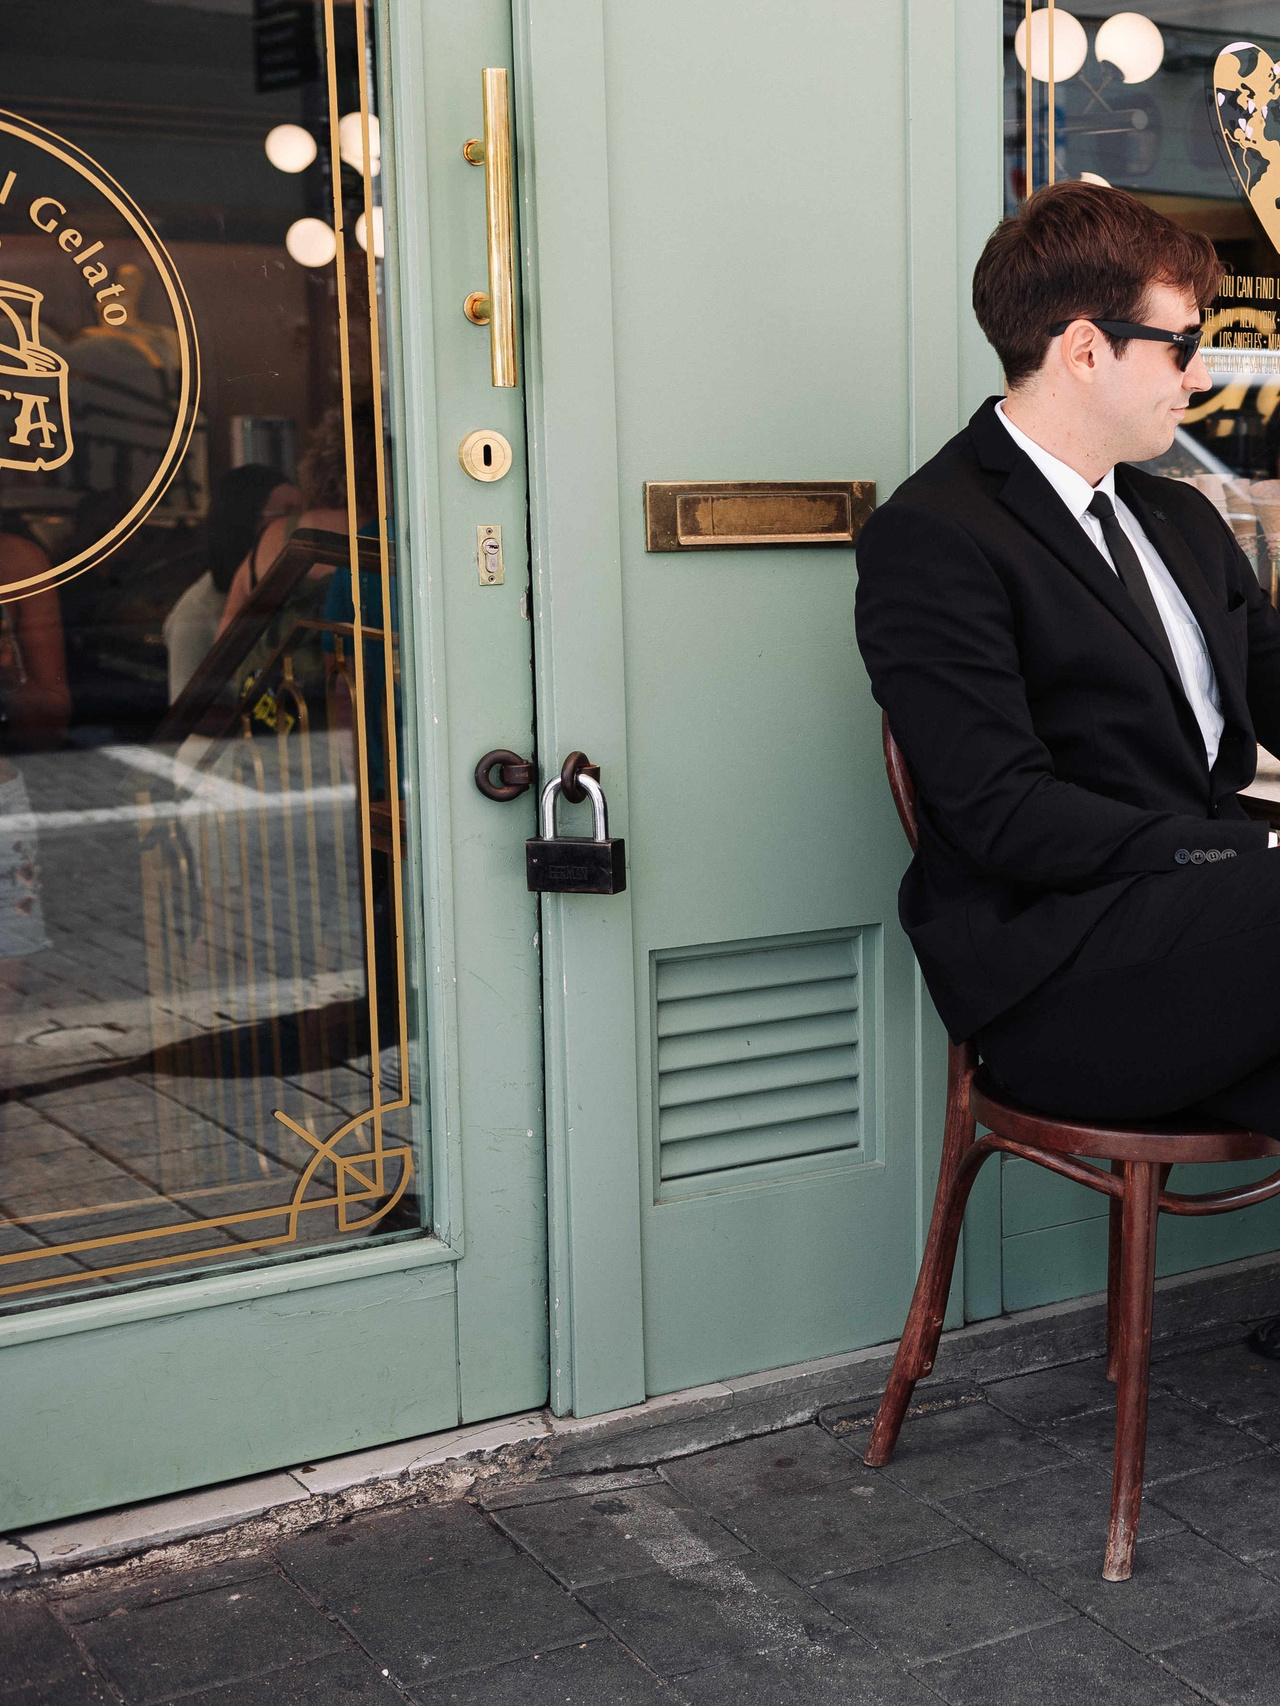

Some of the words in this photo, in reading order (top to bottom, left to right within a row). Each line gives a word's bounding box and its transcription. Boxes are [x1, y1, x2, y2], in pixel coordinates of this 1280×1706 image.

[29, 196, 128, 326] Gelato
[1236, 275, 1253, 299] CAN
[1255, 276, 1274, 300] FIND
[1240, 309, 1255, 329] NEW
[1258, 310, 1277, 330] YORK
[1219, 331, 1232, 350] LOS
[1233, 332, 1263, 350] ANGELES
